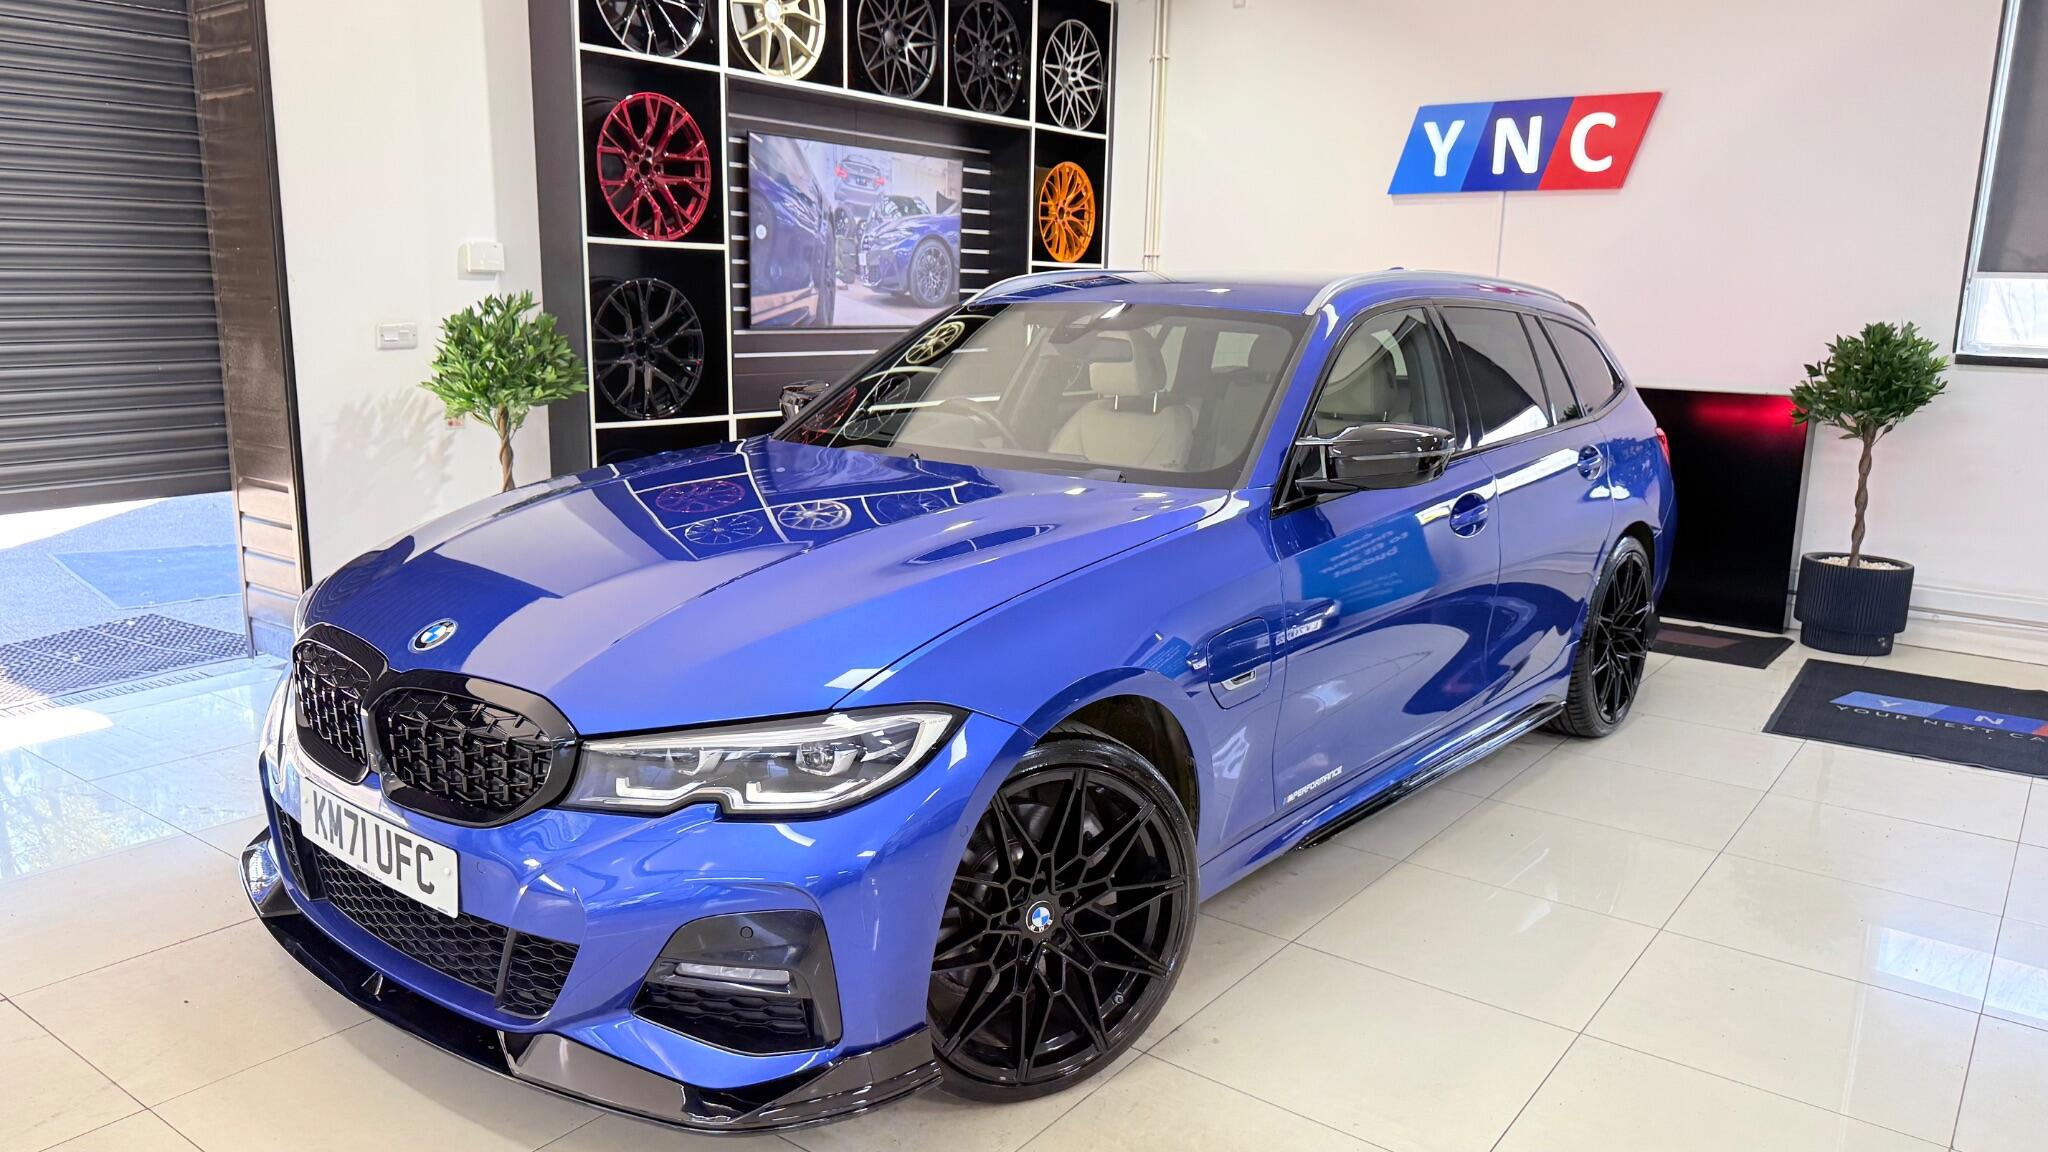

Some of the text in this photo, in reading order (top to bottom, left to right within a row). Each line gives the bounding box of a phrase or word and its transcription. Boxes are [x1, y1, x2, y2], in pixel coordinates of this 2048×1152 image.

[1424, 112, 1616, 177] YNC
[1836, 705, 1908, 721] YOUR
[1924, 719, 1995, 734] NEXT
[313, 790, 435, 895] KM71 UFC
